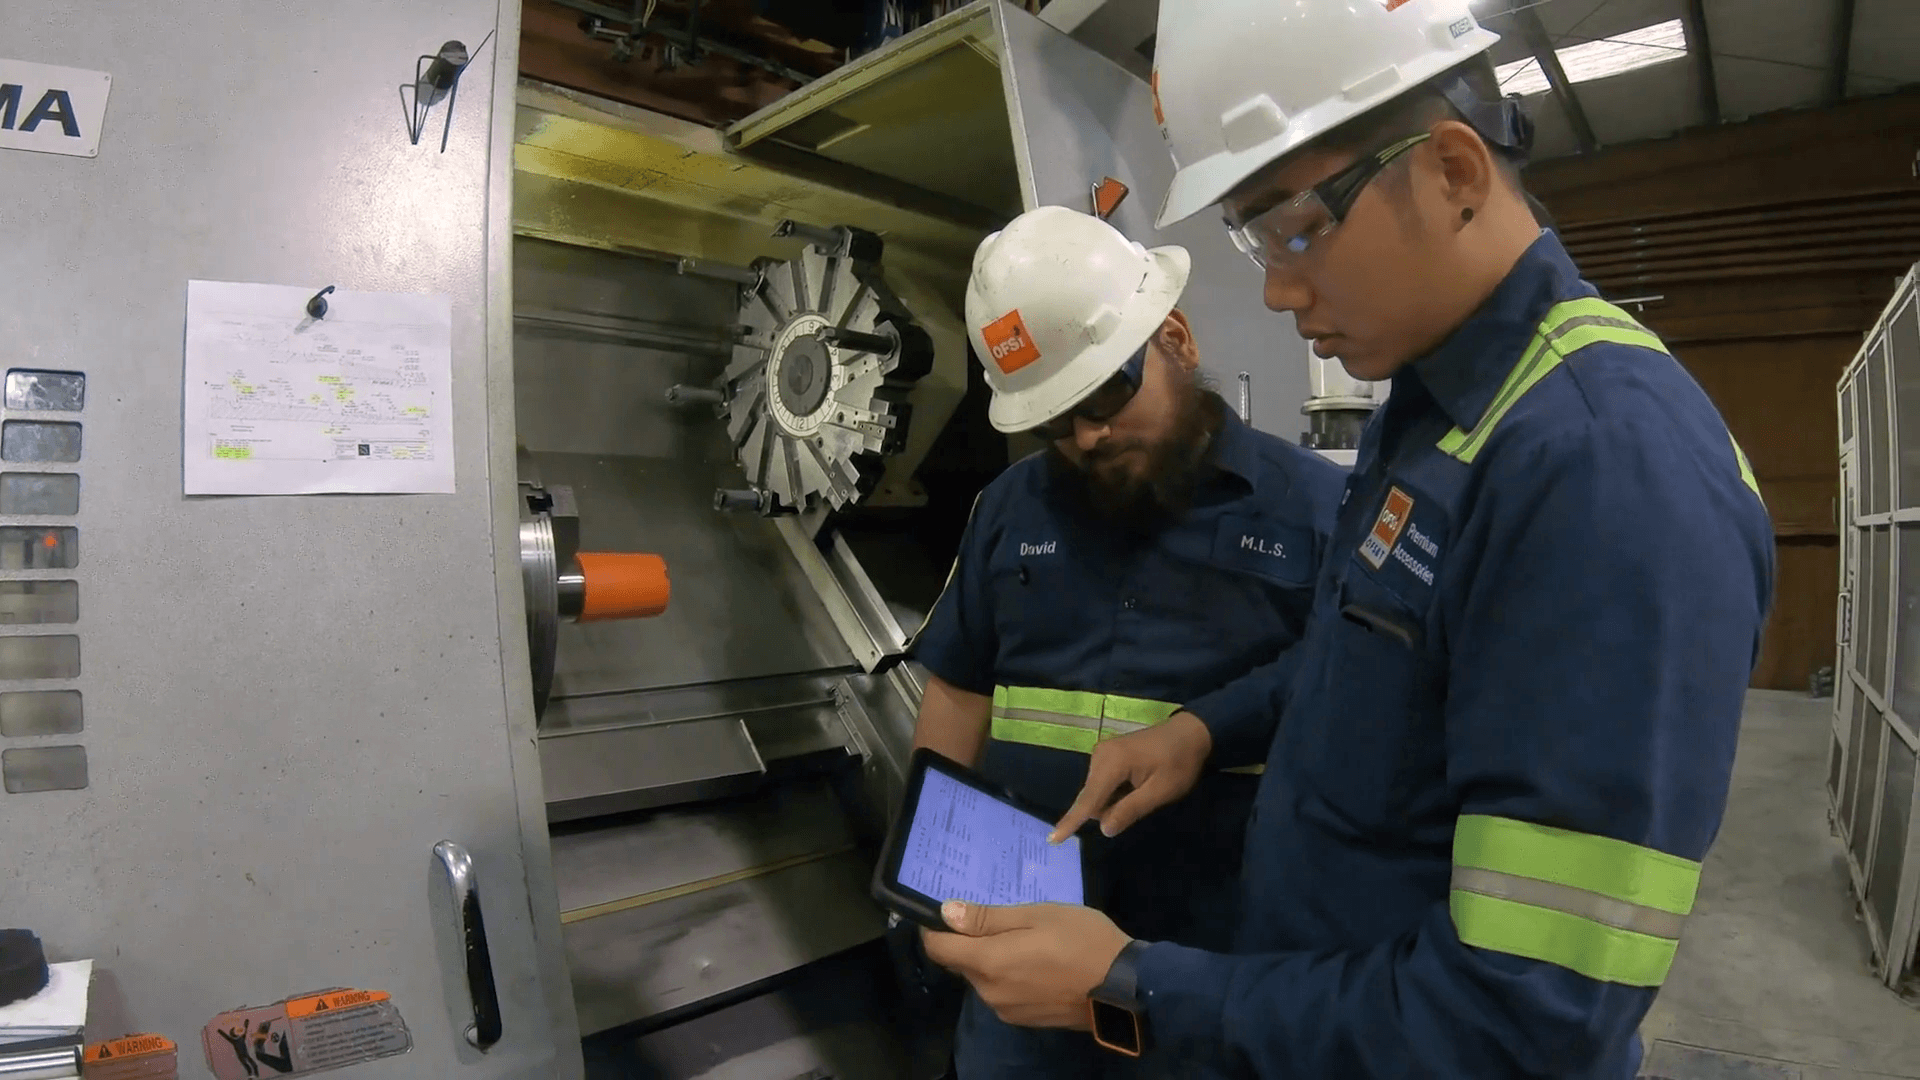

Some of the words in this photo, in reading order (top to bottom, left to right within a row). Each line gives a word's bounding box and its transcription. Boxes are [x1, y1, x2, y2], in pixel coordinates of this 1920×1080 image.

[1020, 541, 1056, 556] David
[1241, 535, 1286, 559] M.L.S.
[1407, 523, 1439, 558] Premium
[1392, 542, 1434, 586] Accessories
[332, 991, 371, 1008] WARNING
[116, 1037, 163, 1055] WARNING
